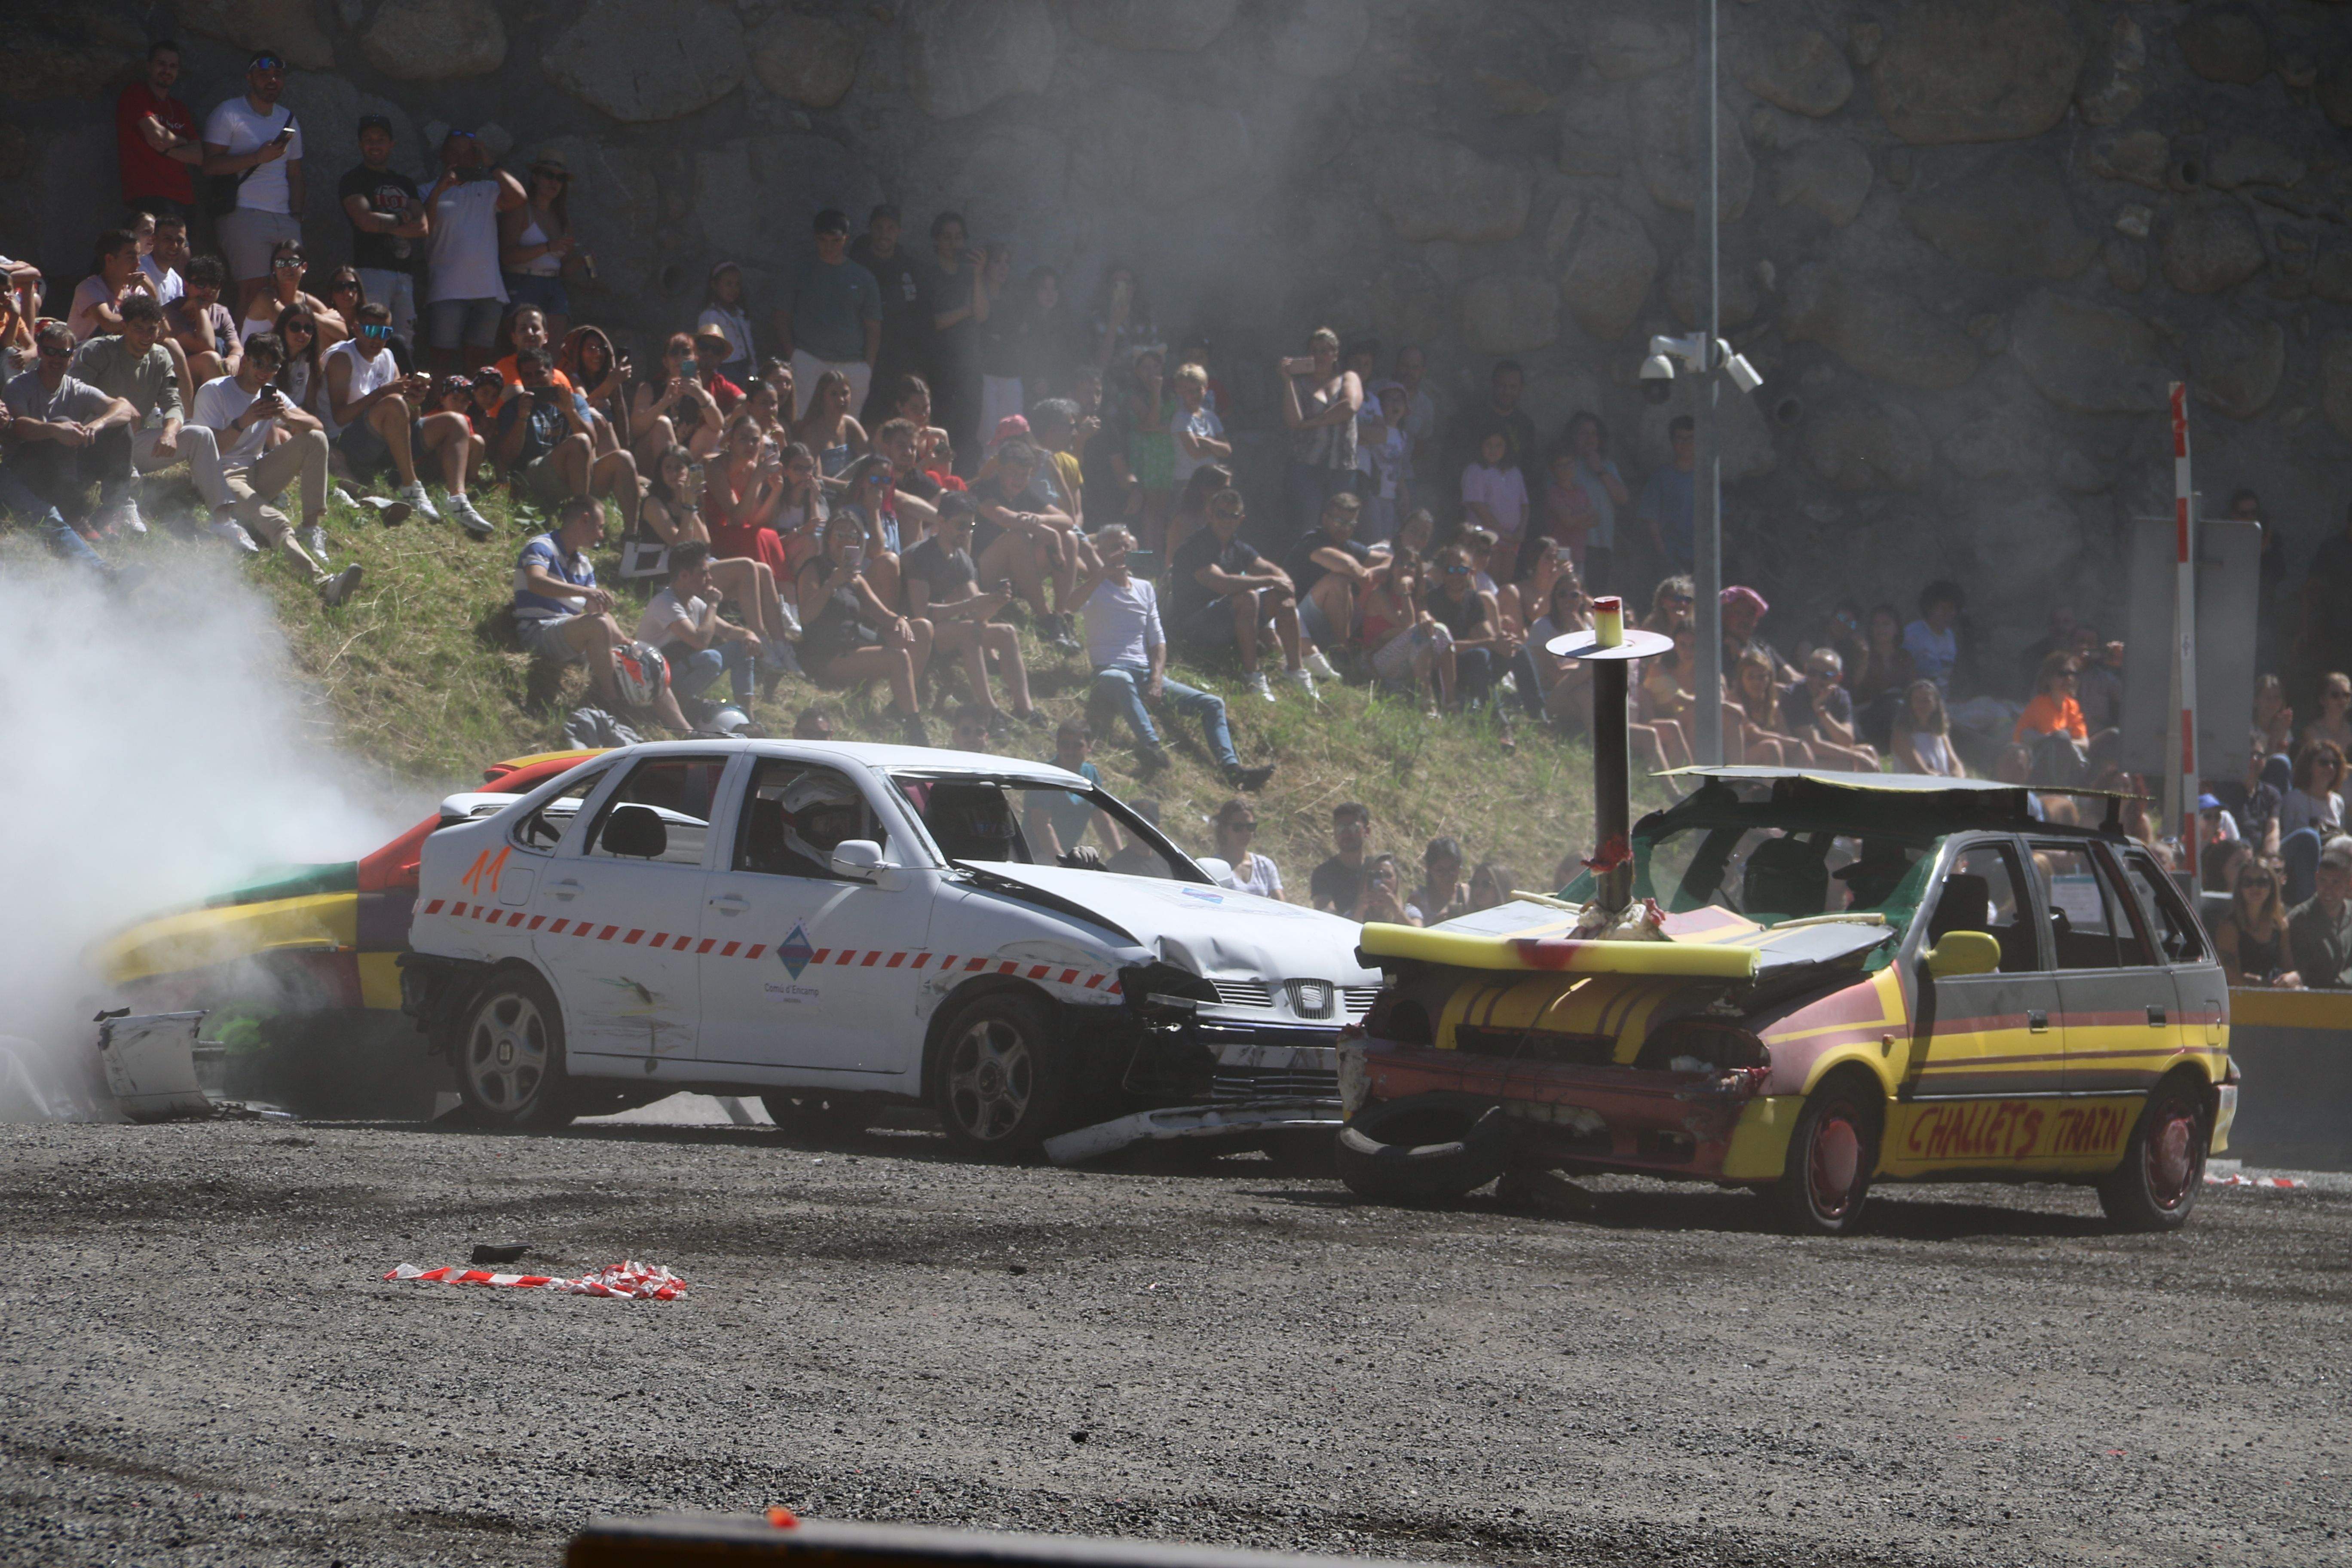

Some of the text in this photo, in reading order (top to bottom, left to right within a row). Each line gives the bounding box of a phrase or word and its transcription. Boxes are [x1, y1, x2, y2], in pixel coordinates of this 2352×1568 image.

[462, 845, 511, 895] 11
[1908, 1102, 2127, 1161] CHALLETS TRAIN
